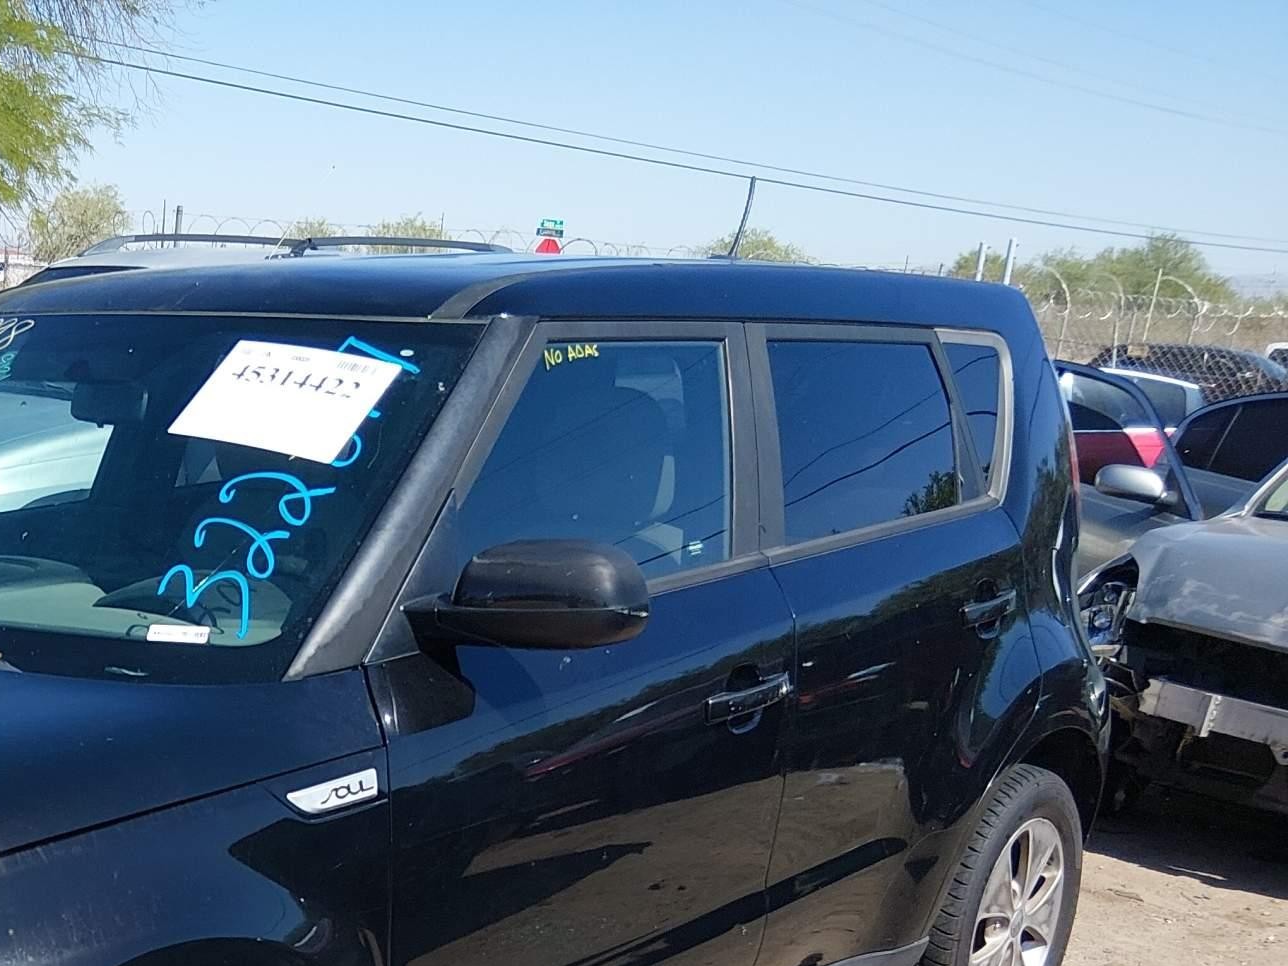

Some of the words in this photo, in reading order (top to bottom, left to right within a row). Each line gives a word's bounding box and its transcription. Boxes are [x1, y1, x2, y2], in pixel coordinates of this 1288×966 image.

[544, 348, 563, 370] NO
[567, 343, 599, 361] ADAS
[232, 364, 361, 399] 45314422
